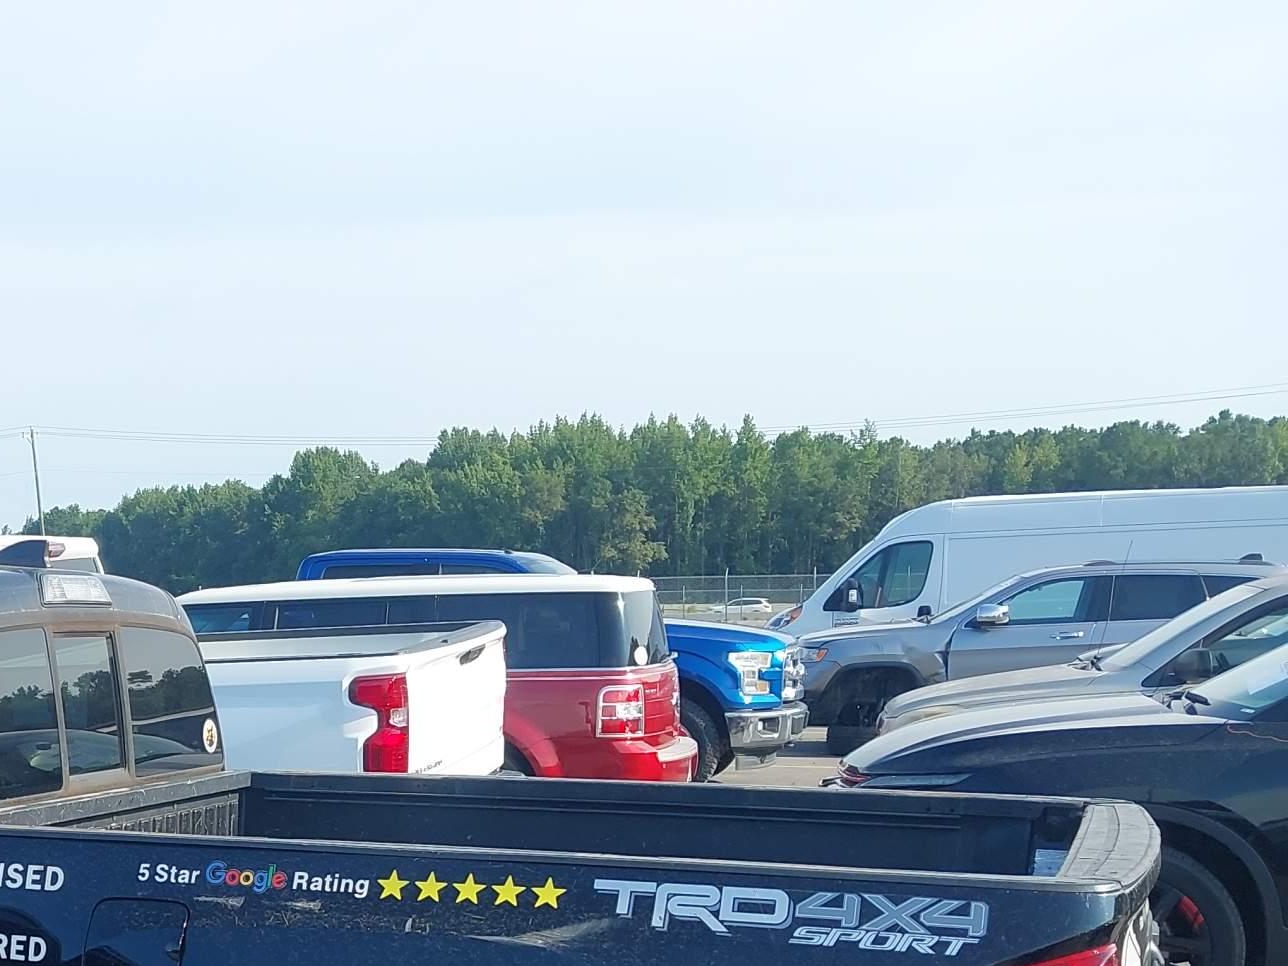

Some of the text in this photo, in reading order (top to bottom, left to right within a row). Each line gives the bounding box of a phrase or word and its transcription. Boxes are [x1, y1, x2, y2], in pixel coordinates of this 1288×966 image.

[137, 860, 370, 898] 5 Star Google Rating
[593, 878, 793, 936] TRD
[788, 926, 982, 956] SPORT
